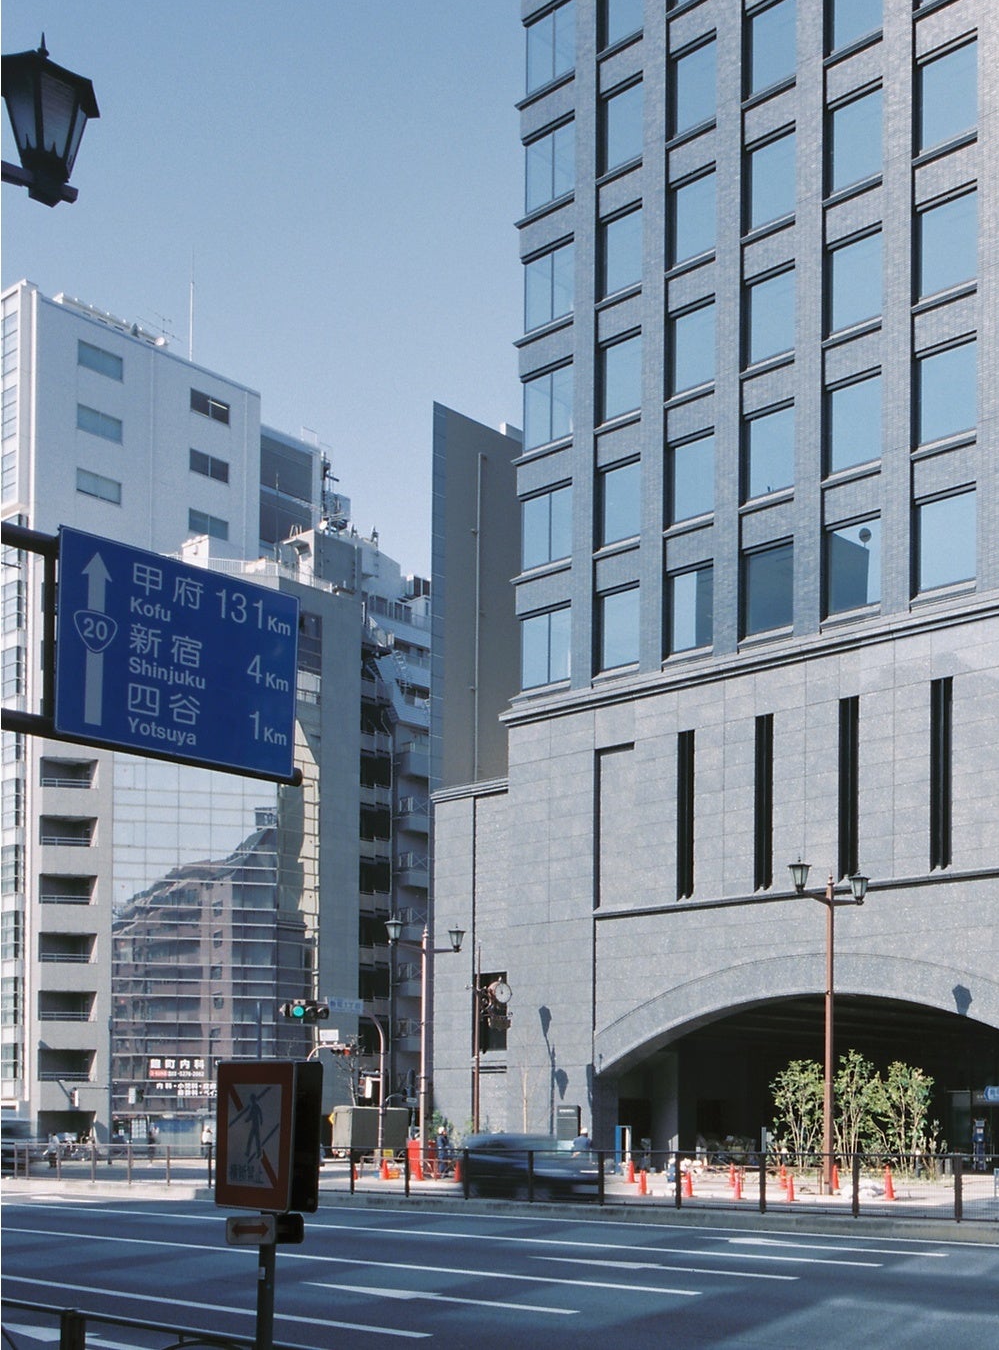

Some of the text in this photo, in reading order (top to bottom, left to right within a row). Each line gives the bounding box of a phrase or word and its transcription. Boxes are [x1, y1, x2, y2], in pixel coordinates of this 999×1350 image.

[133, 562, 204, 610] 甲府
[130, 596, 171, 622] Kofu
[83, 618, 108, 641] 20
[129, 623, 202, 668] 新宿
[128, 657, 206, 690] Shinjuku
[127, 683, 200, 726] 四谷
[127, 716, 197, 746] Yotsuya
